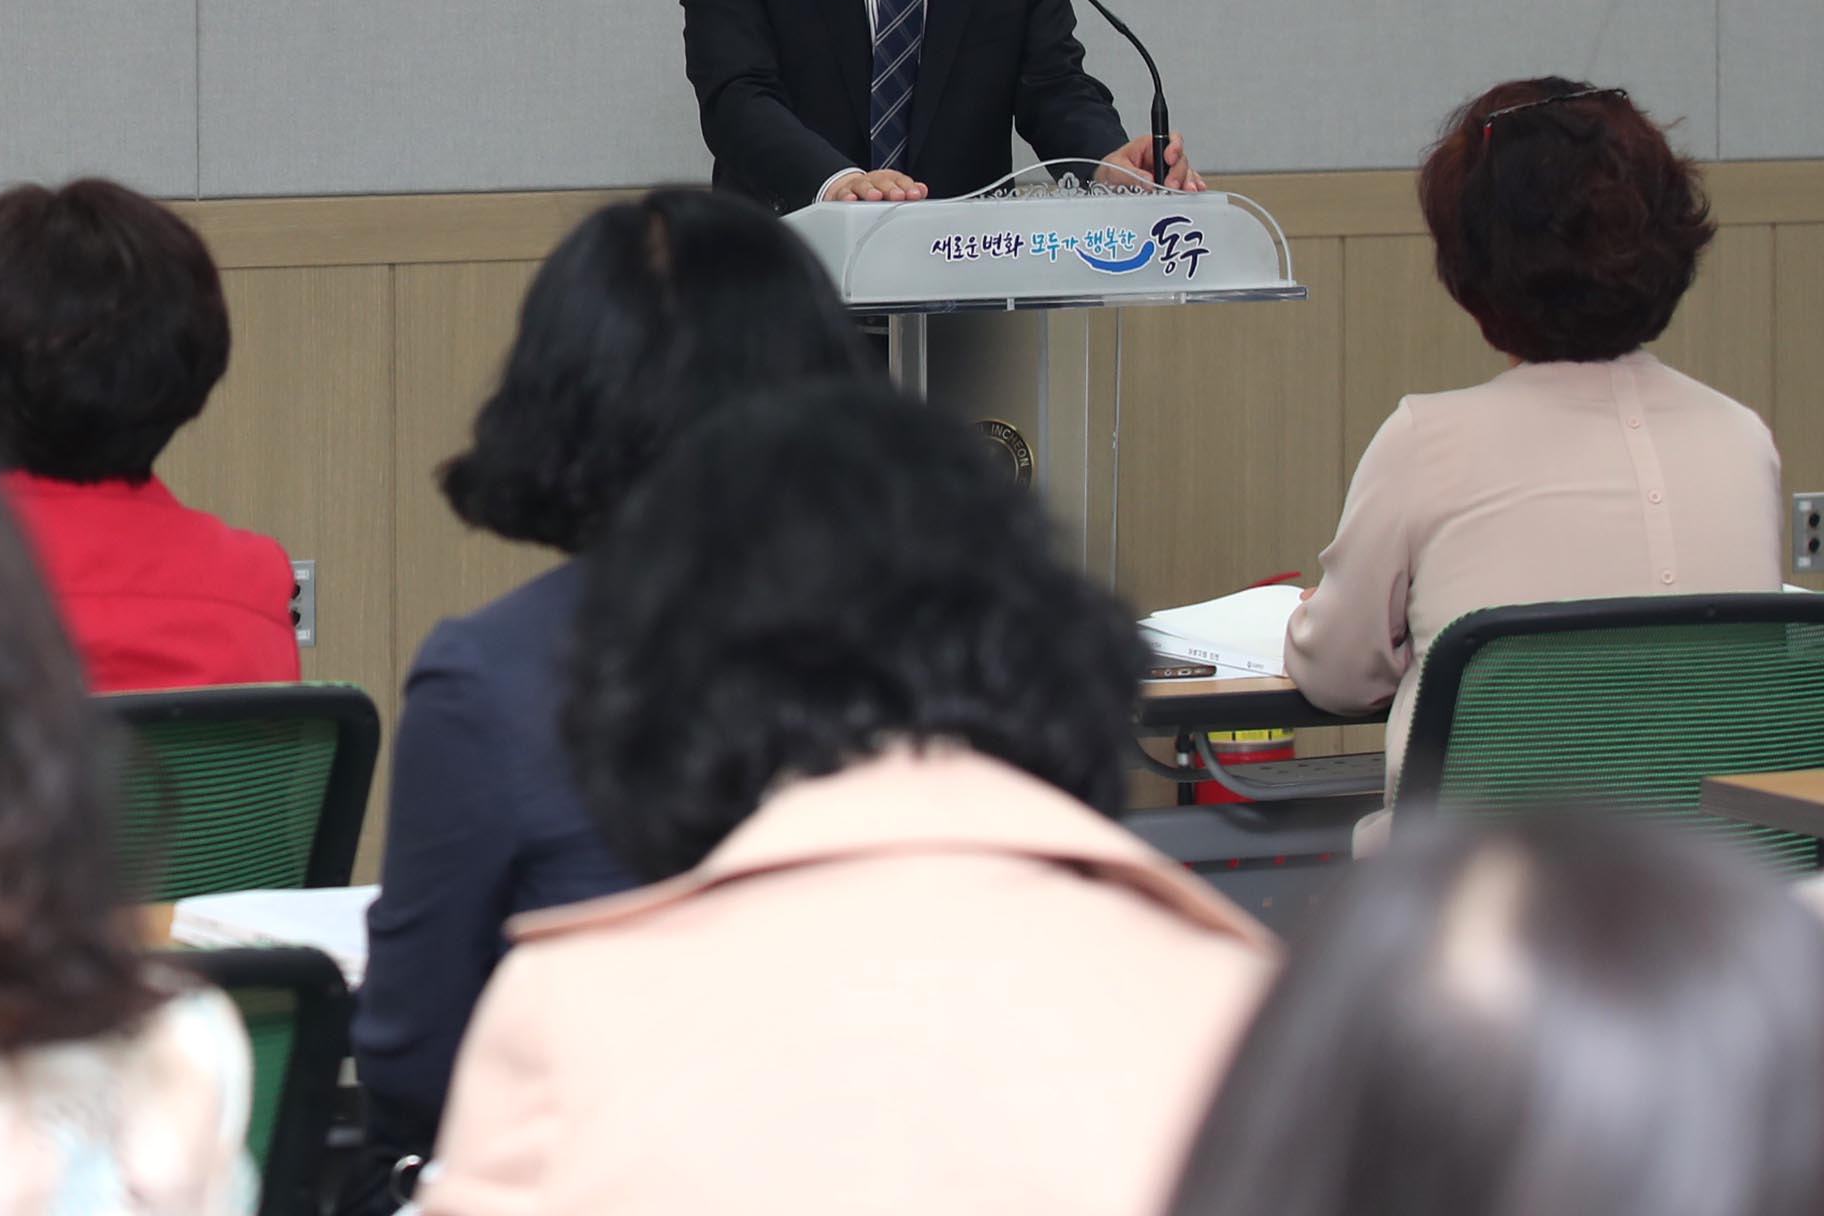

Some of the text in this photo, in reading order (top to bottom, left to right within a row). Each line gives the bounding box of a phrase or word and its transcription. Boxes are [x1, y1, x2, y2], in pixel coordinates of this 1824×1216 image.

[1030, 232, 1078, 261] 모두가
[1084, 227, 1136, 258] 행복한
[1152, 215, 1210, 278] 동구
[991, 423, 1030, 467] INCHEON
